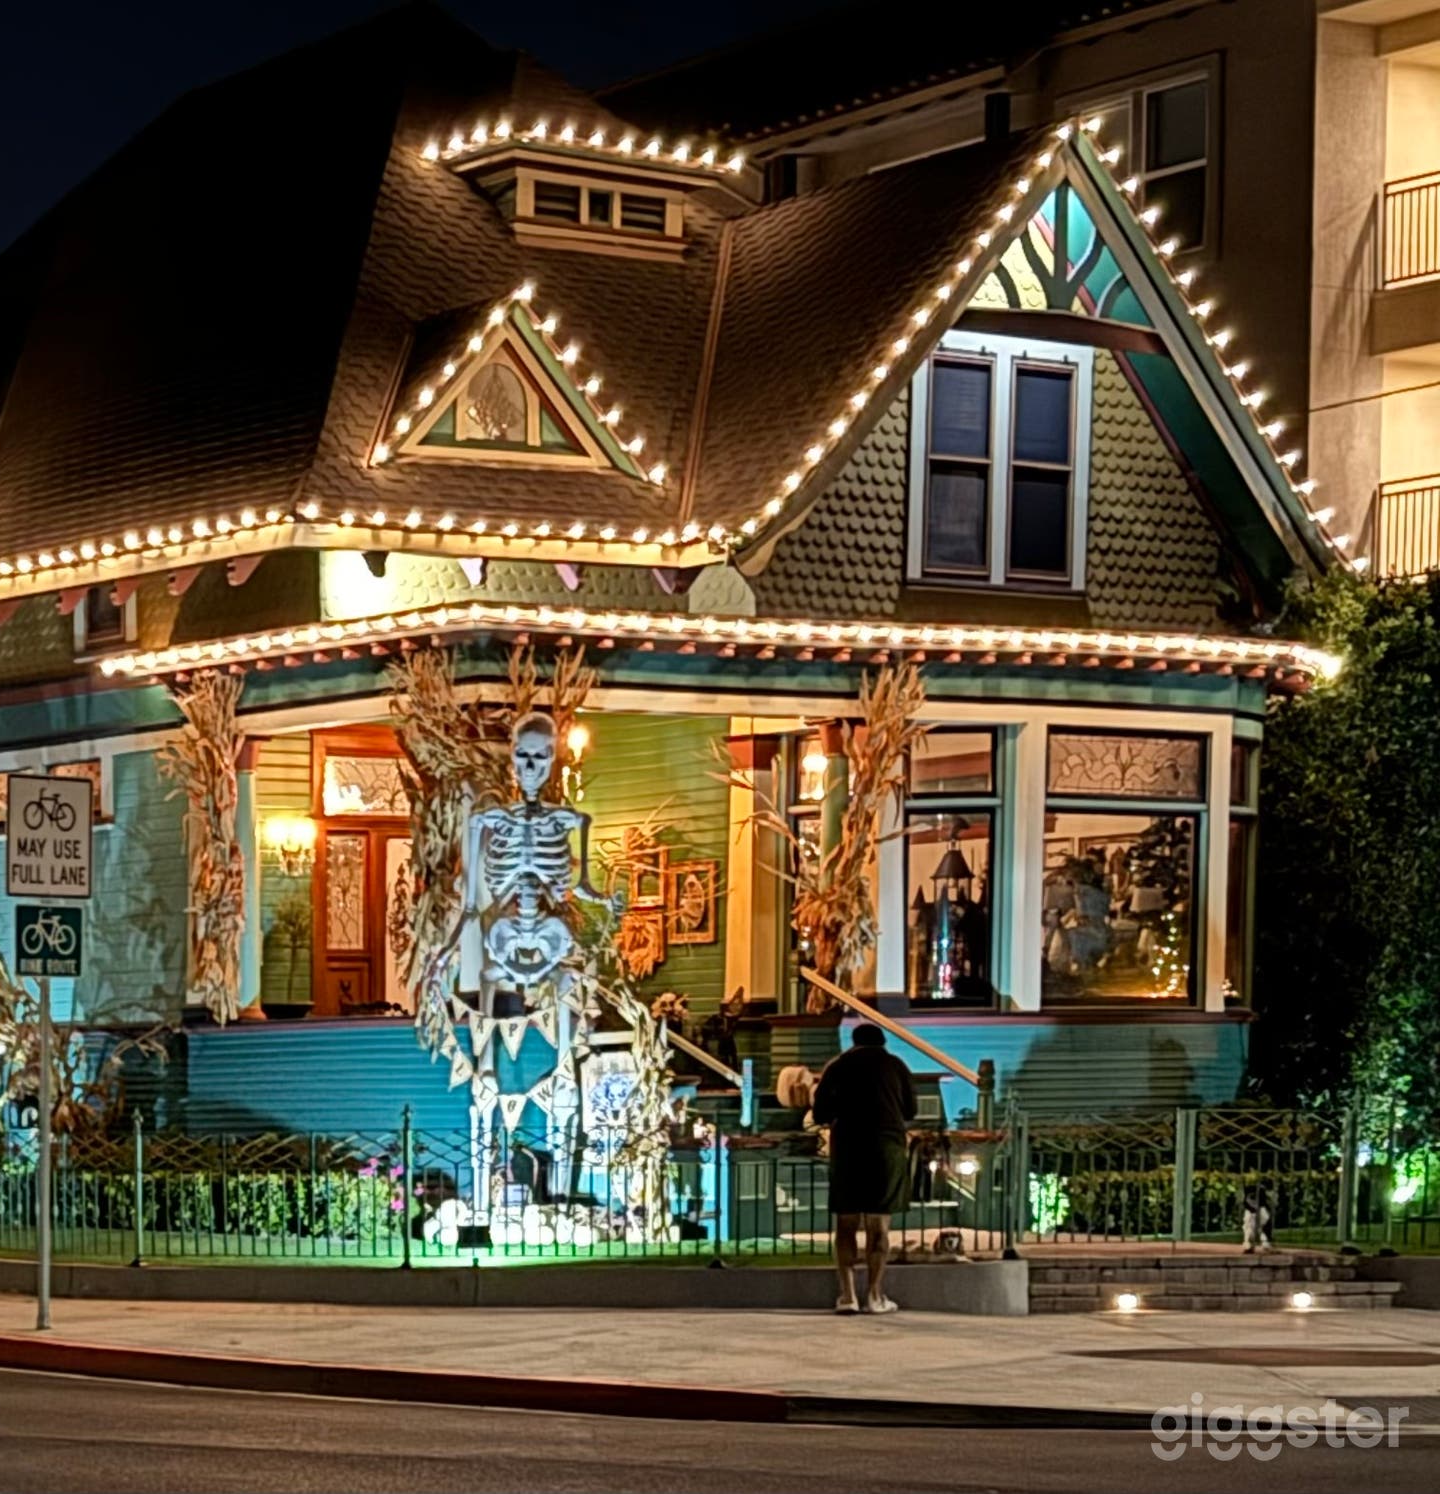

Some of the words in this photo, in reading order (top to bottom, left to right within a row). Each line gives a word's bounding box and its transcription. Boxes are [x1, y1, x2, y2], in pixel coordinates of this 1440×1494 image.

[17, 837, 47, 858] MAY
[53, 839, 82, 860] USE
[12, 863, 45, 885] FULL
[50, 864, 86, 886] LANE
